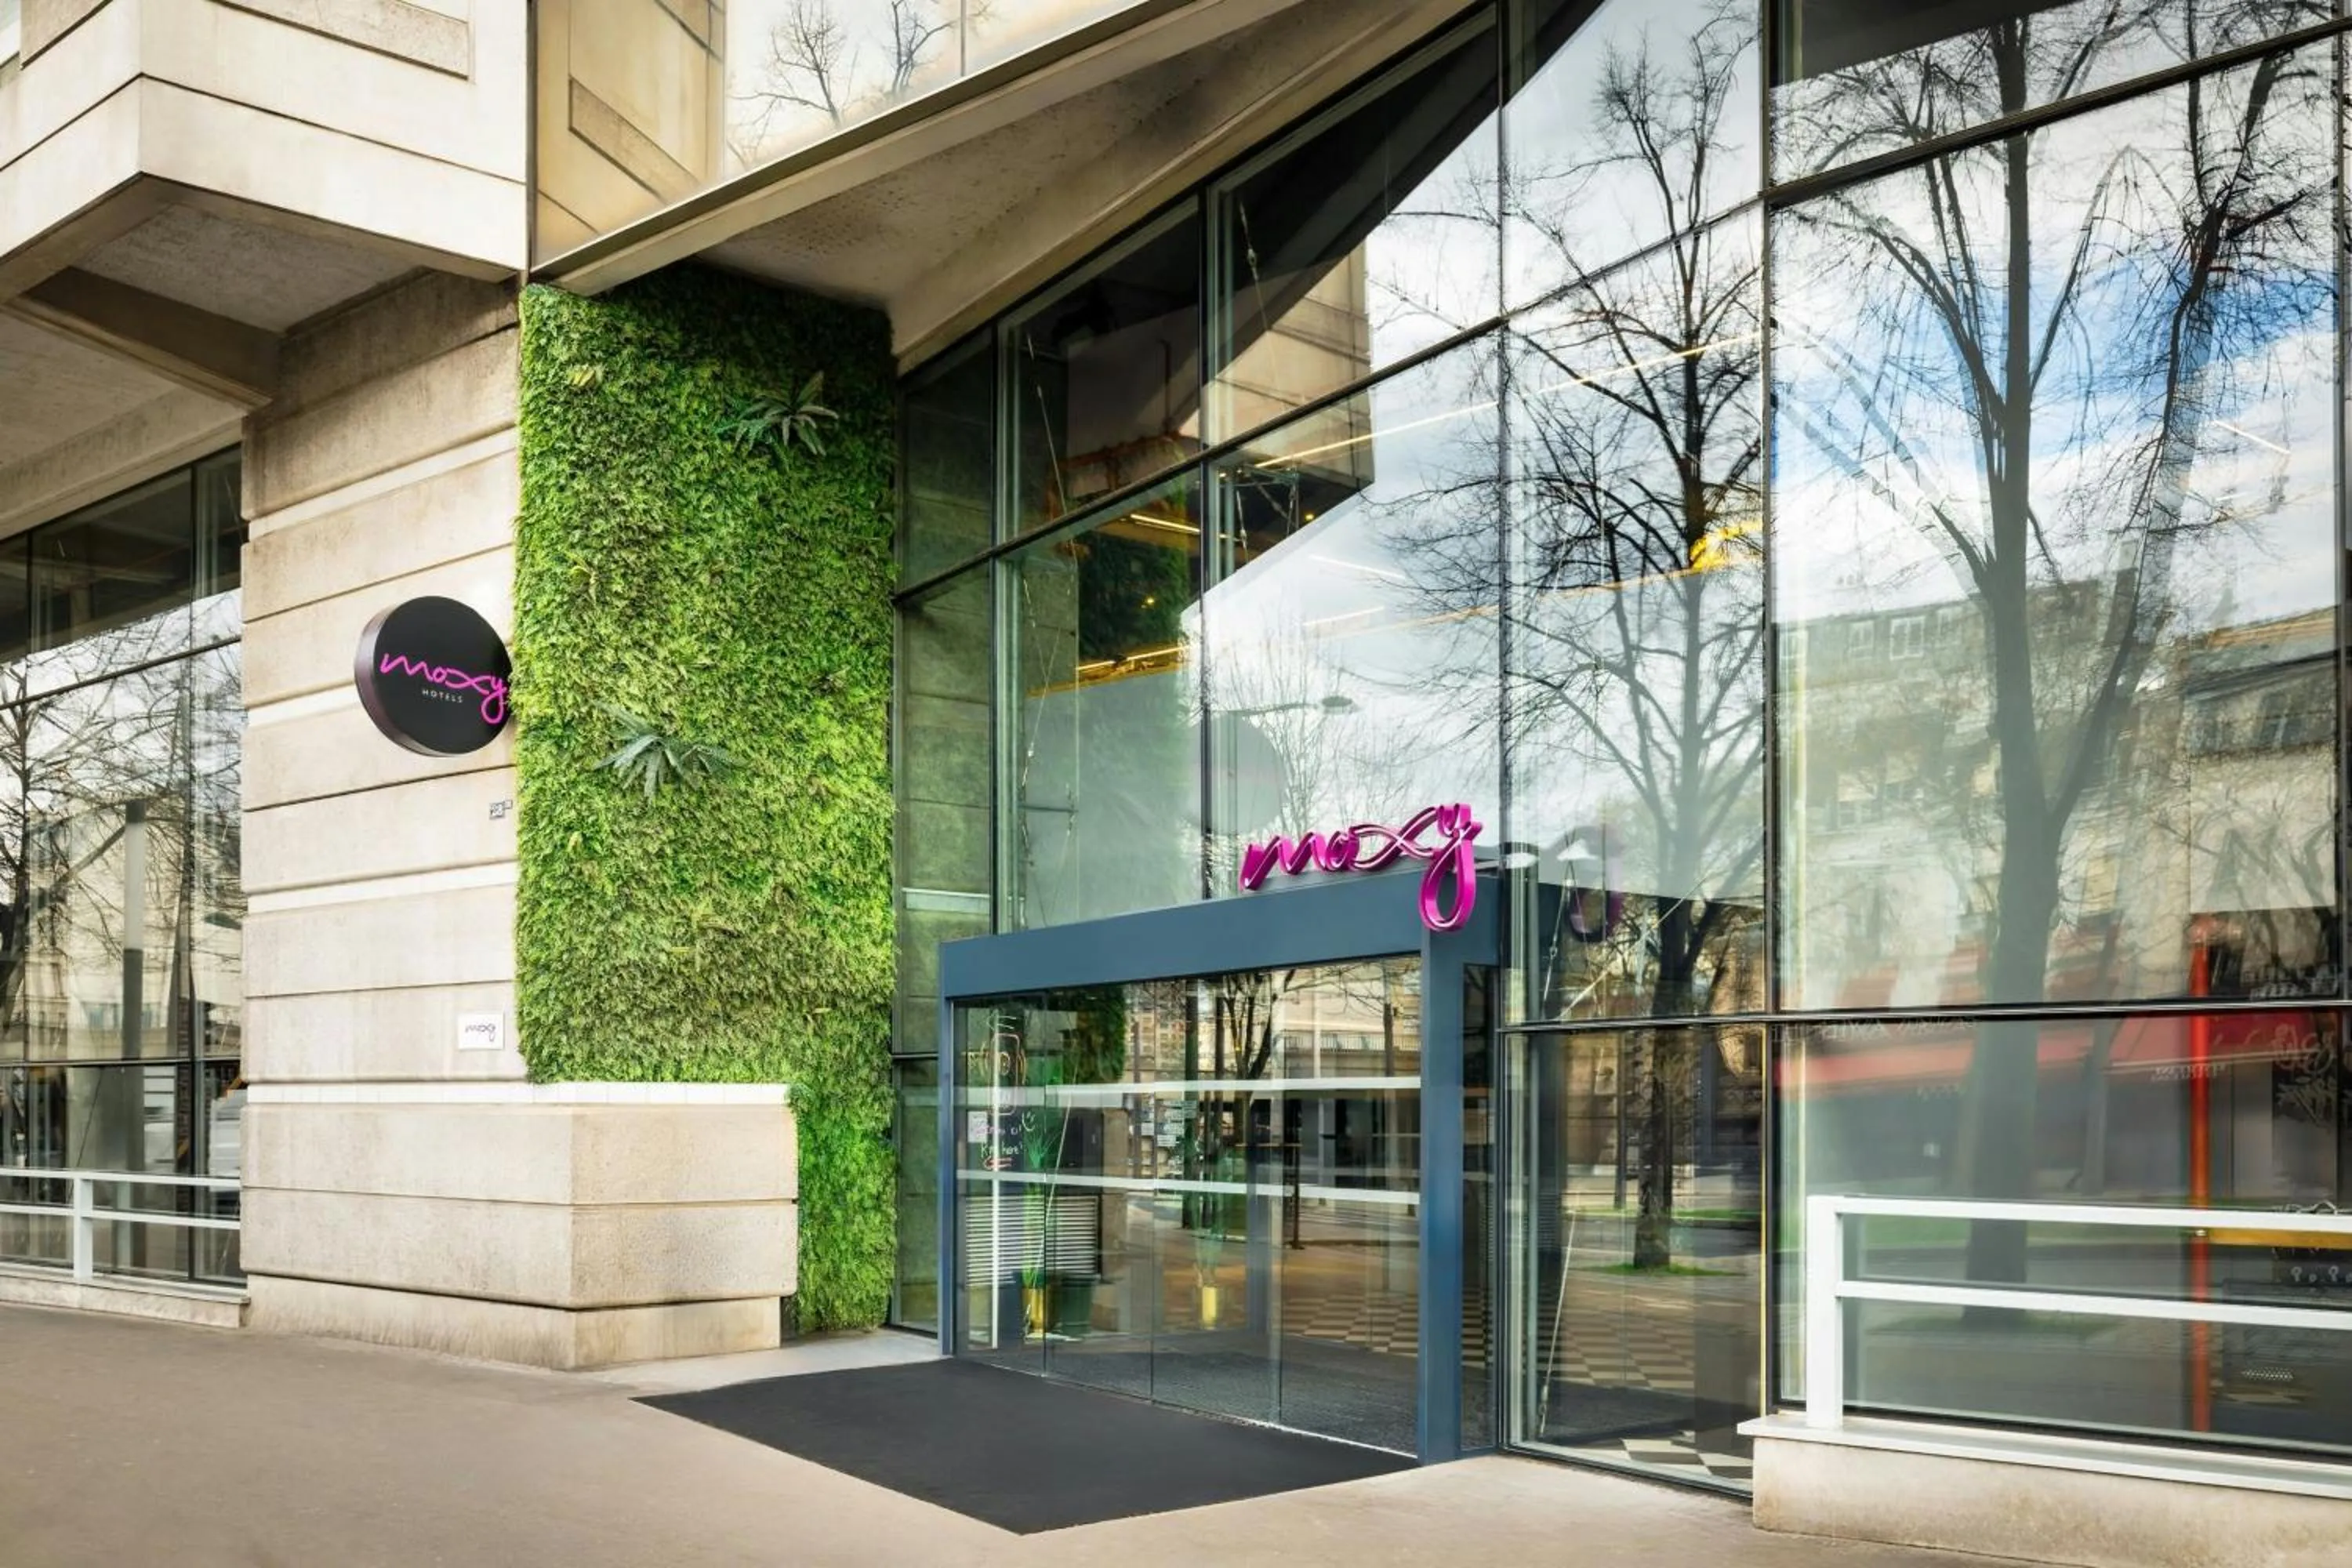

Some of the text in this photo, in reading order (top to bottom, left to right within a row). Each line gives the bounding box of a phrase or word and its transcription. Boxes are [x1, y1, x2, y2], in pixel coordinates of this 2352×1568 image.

[379, 652, 507, 724] moxy
[422, 689, 463, 703] HOTELS
[1240, 803, 1483, 932] moxy
